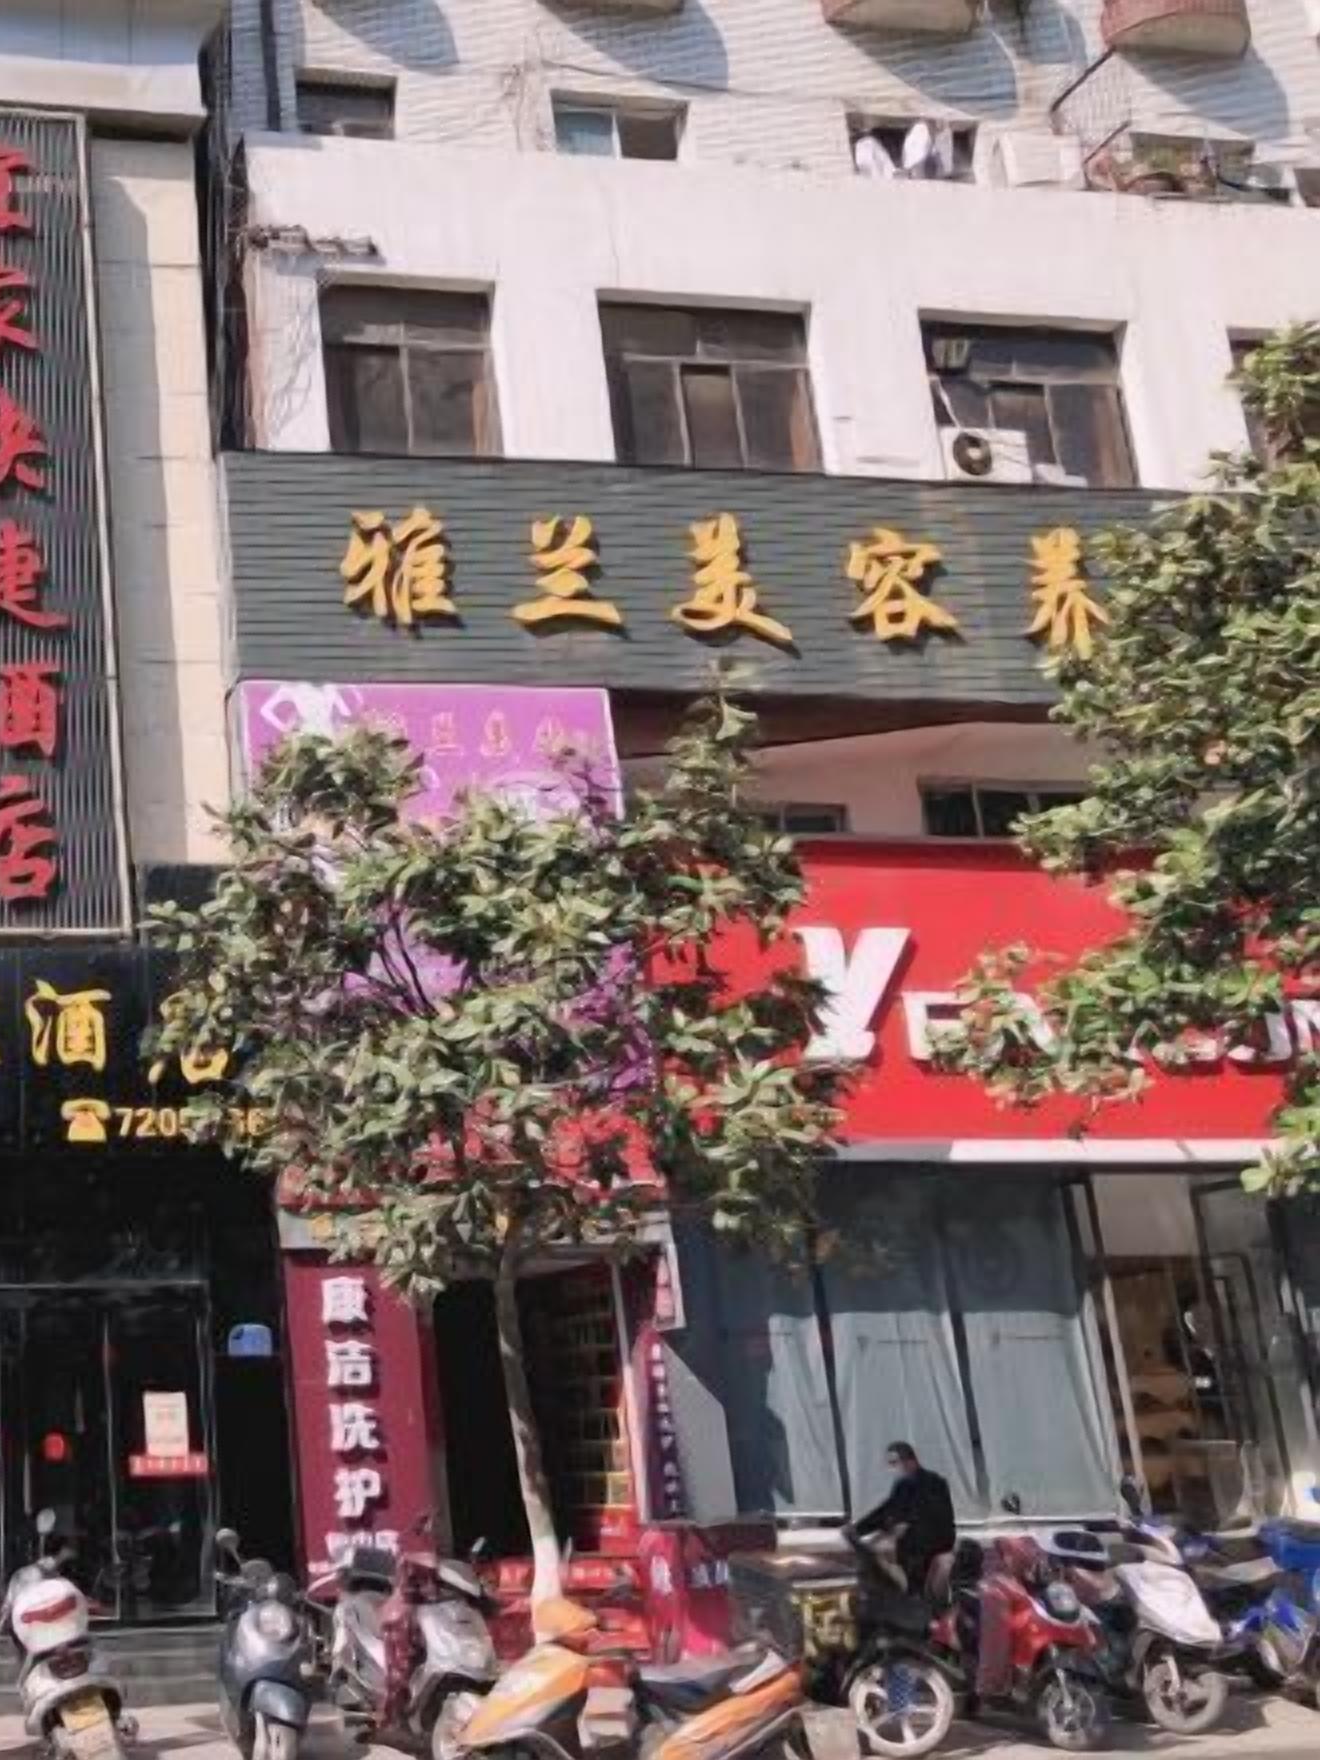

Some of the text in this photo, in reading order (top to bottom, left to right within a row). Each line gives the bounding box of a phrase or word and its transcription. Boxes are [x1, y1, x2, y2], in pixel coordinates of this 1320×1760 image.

[339, 506, 1112, 662] 雅兰美容养
[114, 1107, 268, 1138] 7206
